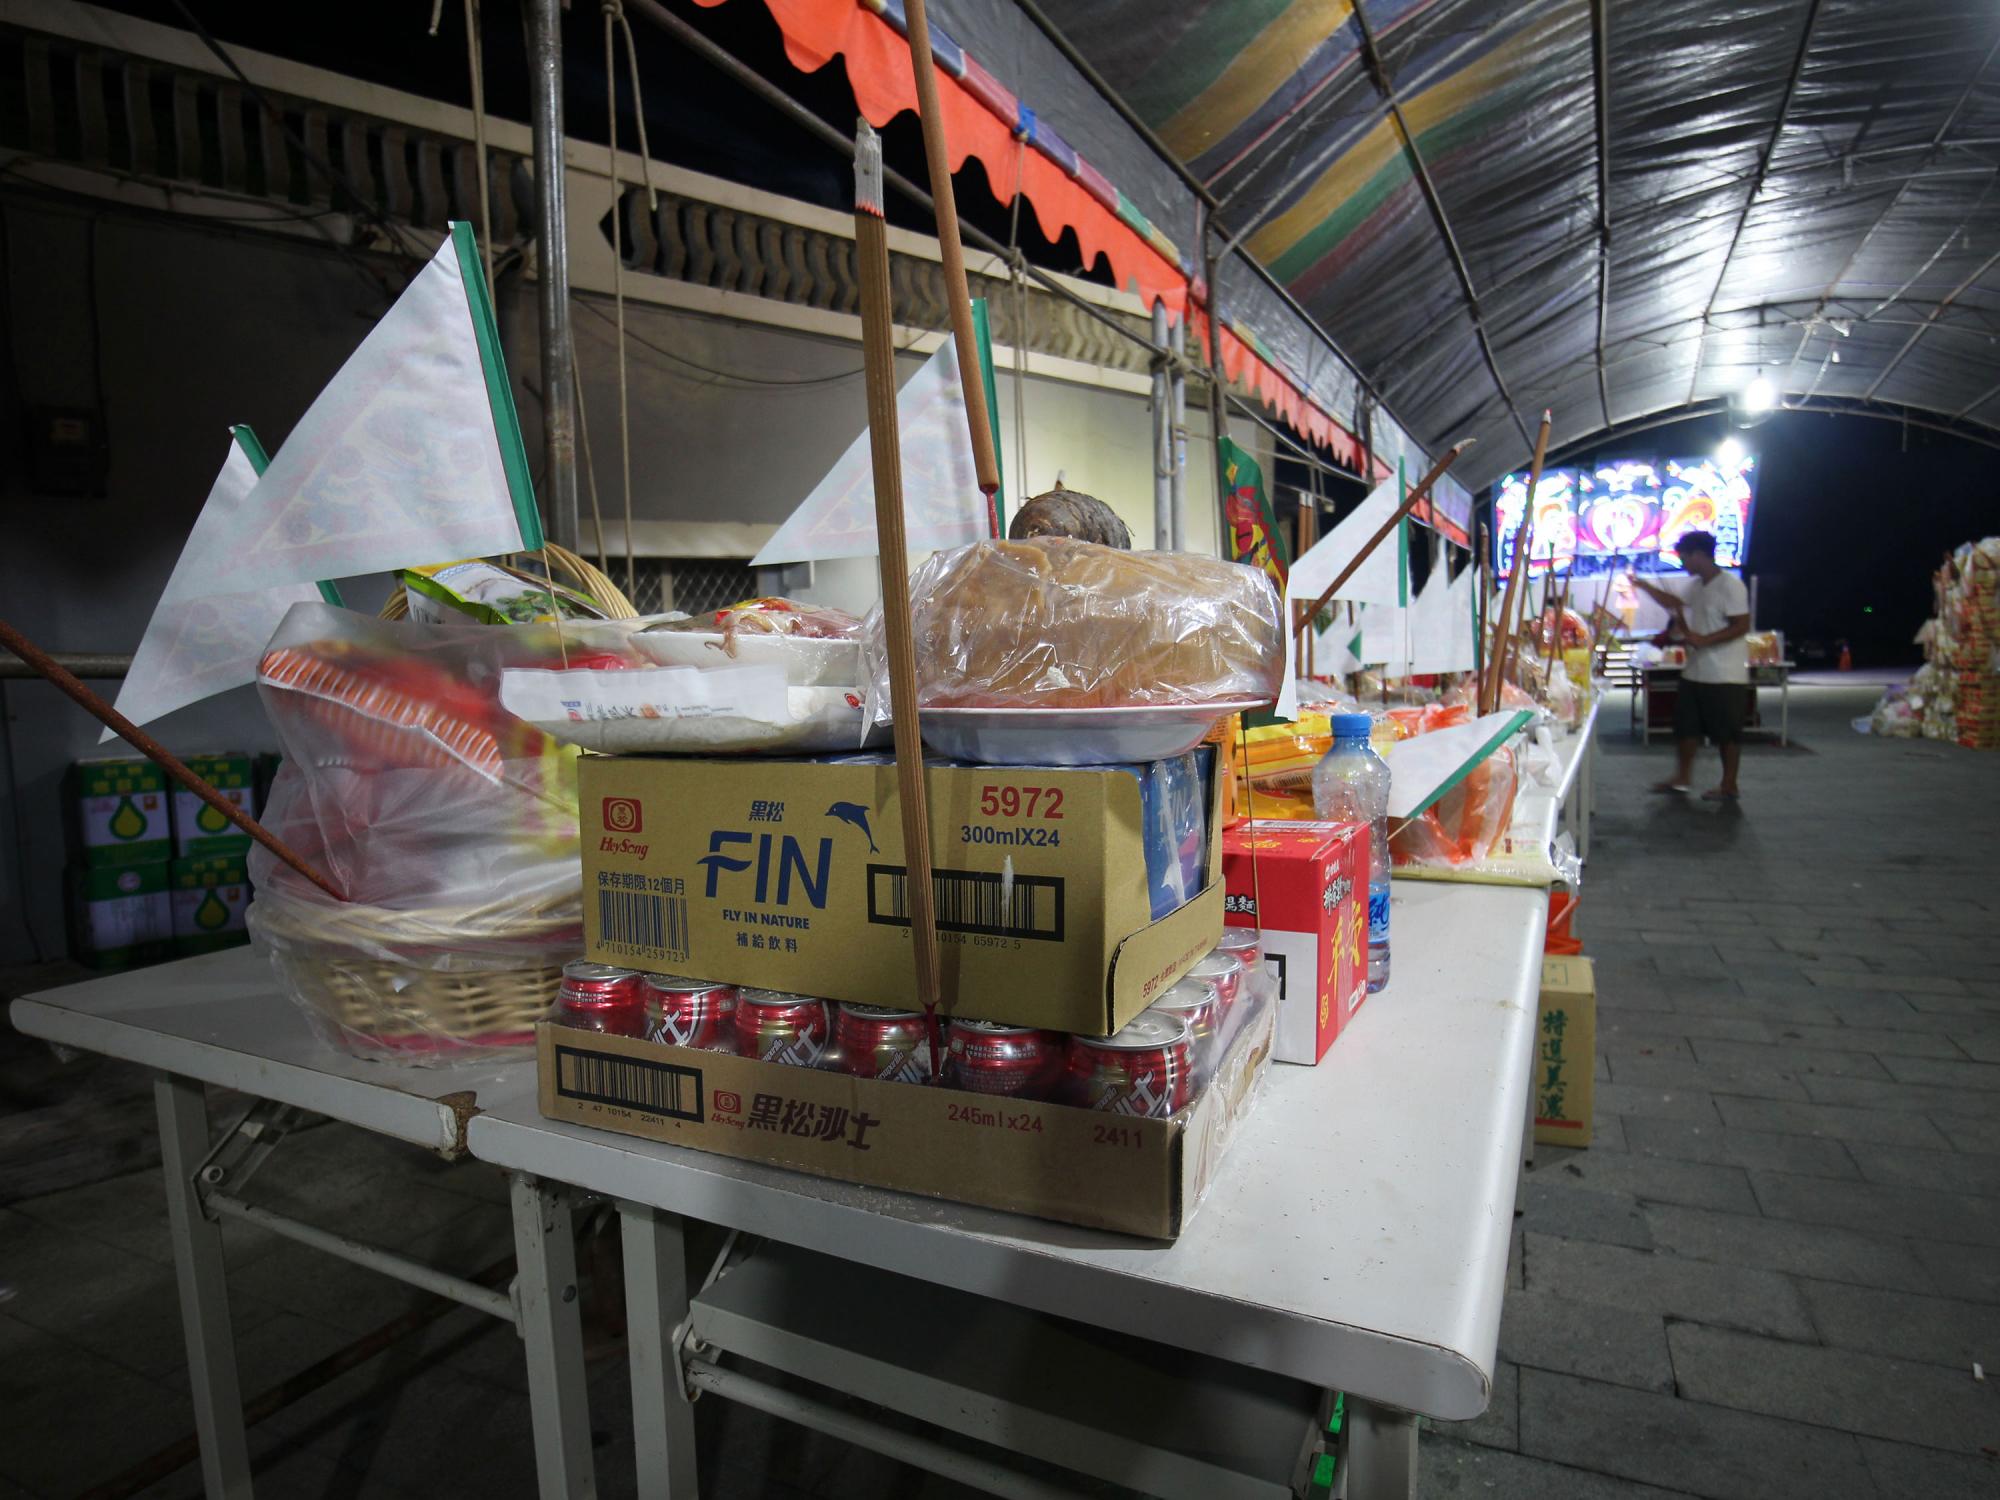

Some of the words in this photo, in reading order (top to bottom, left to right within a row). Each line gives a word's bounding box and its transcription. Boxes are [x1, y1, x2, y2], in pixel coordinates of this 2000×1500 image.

[748, 800, 785, 823] 黑松
[980, 786, 1064, 819] 5972
[961, 825, 1060, 848] 300mlX24
[696, 830, 832, 909] FIN
[598, 871, 686, 896] 保存期限12個月
[723, 908, 742, 923] FLY
[744, 911, 757, 924] IN
[760, 913, 810, 930] NATURE
[605, 942, 642, 956] 710154
[647, 948, 686, 963] 259723
[736, 931, 799, 953] 補給飲料
[748, 1093, 880, 1150] 黑松沙士
[1094, 1125, 1143, 1149] 2411
